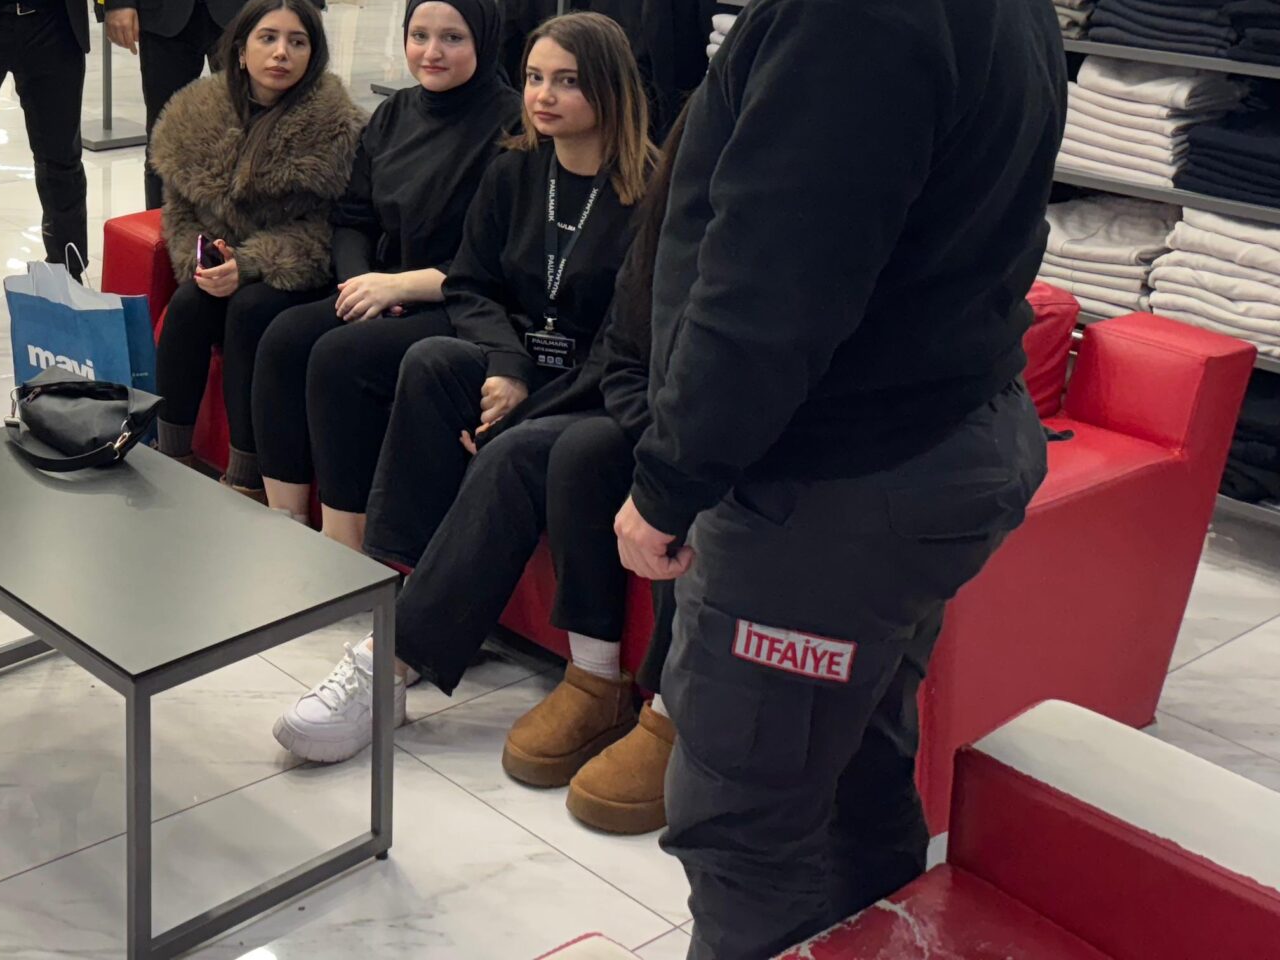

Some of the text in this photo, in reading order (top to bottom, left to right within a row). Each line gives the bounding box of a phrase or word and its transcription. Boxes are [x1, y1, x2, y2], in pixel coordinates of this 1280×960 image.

[548, 179, 556, 221] PAULMARK
[577, 188, 598, 229] PAULMARK
[549, 259, 566, 299] PAULMARK
[532, 338, 569, 347] PAULMARK
[743, 623, 844, 676] İTFAİYE
